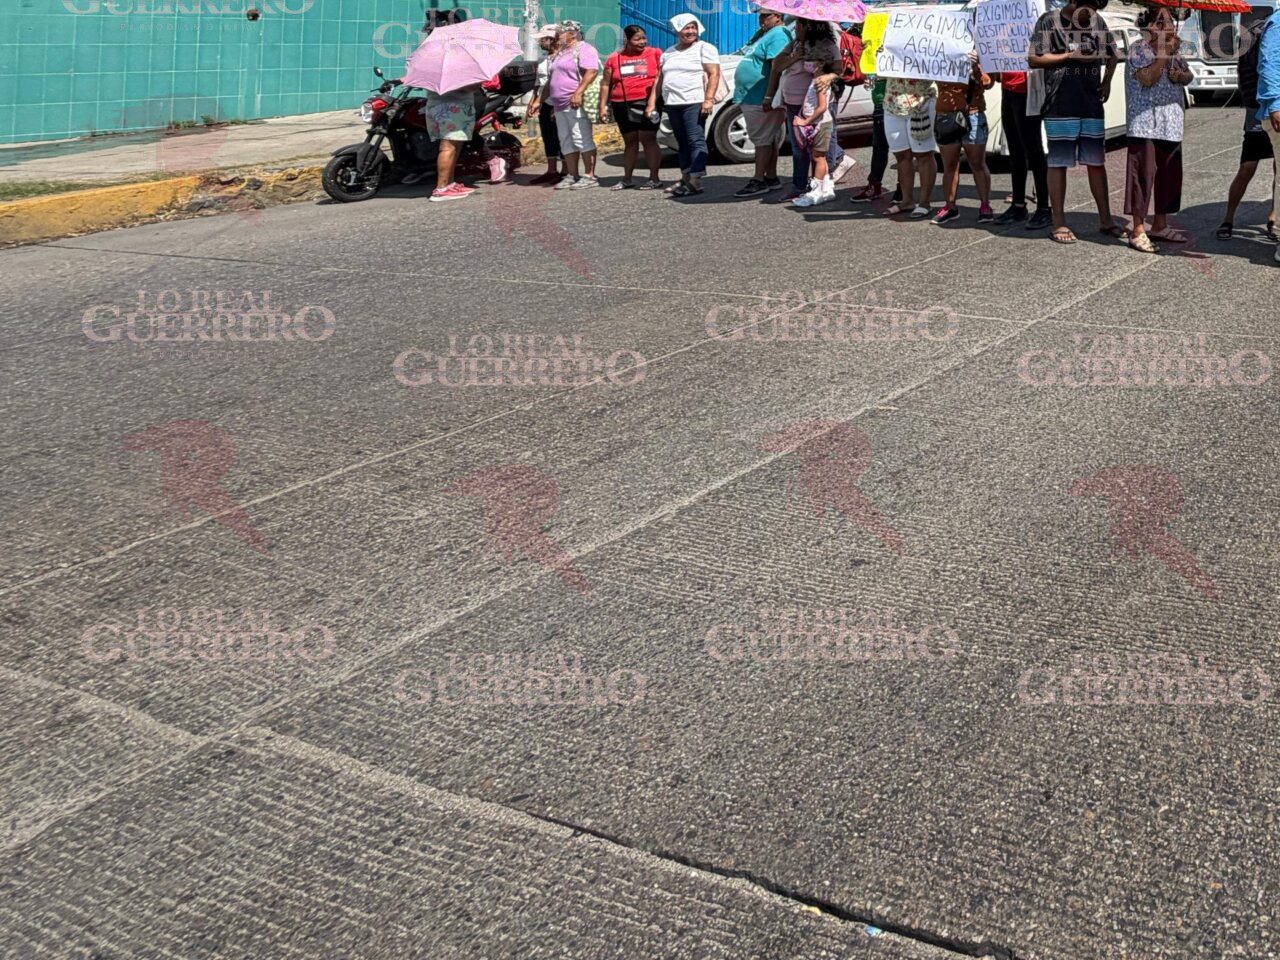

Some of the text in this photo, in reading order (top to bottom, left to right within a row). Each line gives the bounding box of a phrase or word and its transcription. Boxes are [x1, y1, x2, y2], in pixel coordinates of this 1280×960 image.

[977, 1, 1039, 23] EXIGIMOS LA
[893, 13, 974, 44] EXIGIMOS
[904, 35, 946, 61] AGUA
[978, 41, 995, 56] DE
[879, 54, 899, 72] COL
